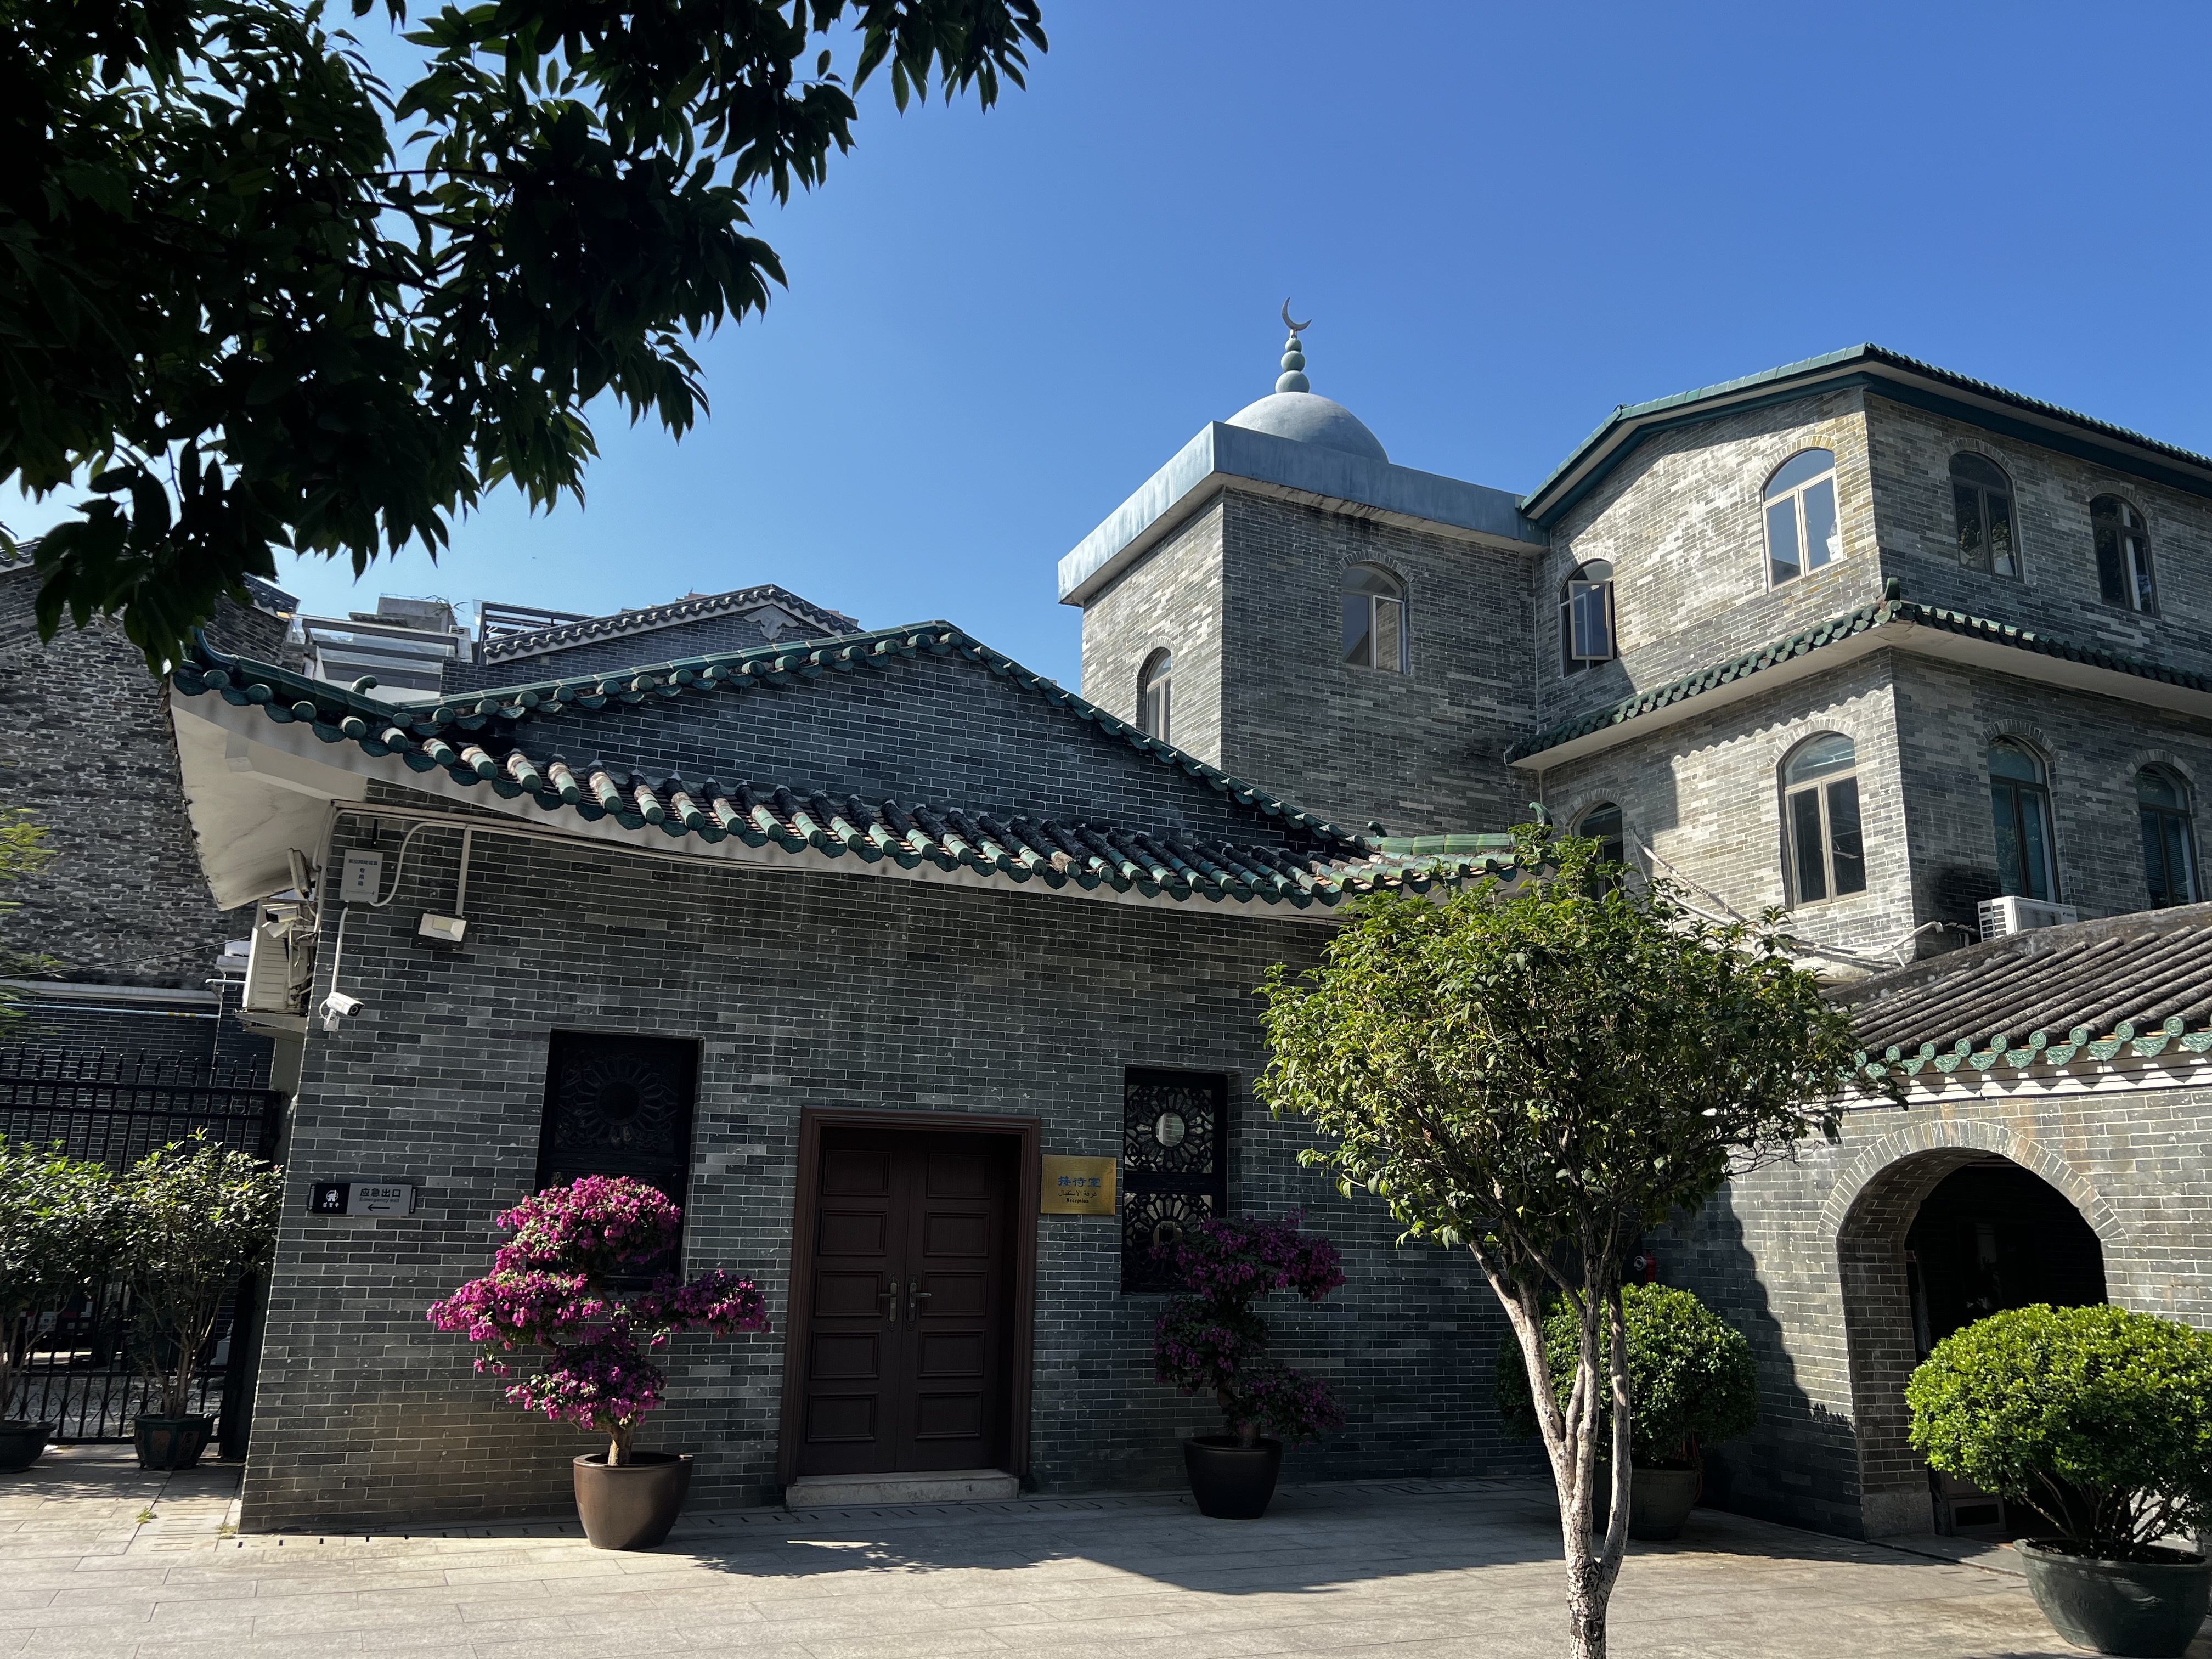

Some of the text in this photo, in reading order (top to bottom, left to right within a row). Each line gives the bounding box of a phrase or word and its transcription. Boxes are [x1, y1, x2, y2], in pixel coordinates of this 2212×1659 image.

[1058, 1176, 1101, 1187] 接待室
[360, 1188, 401, 1197] 应急出口
